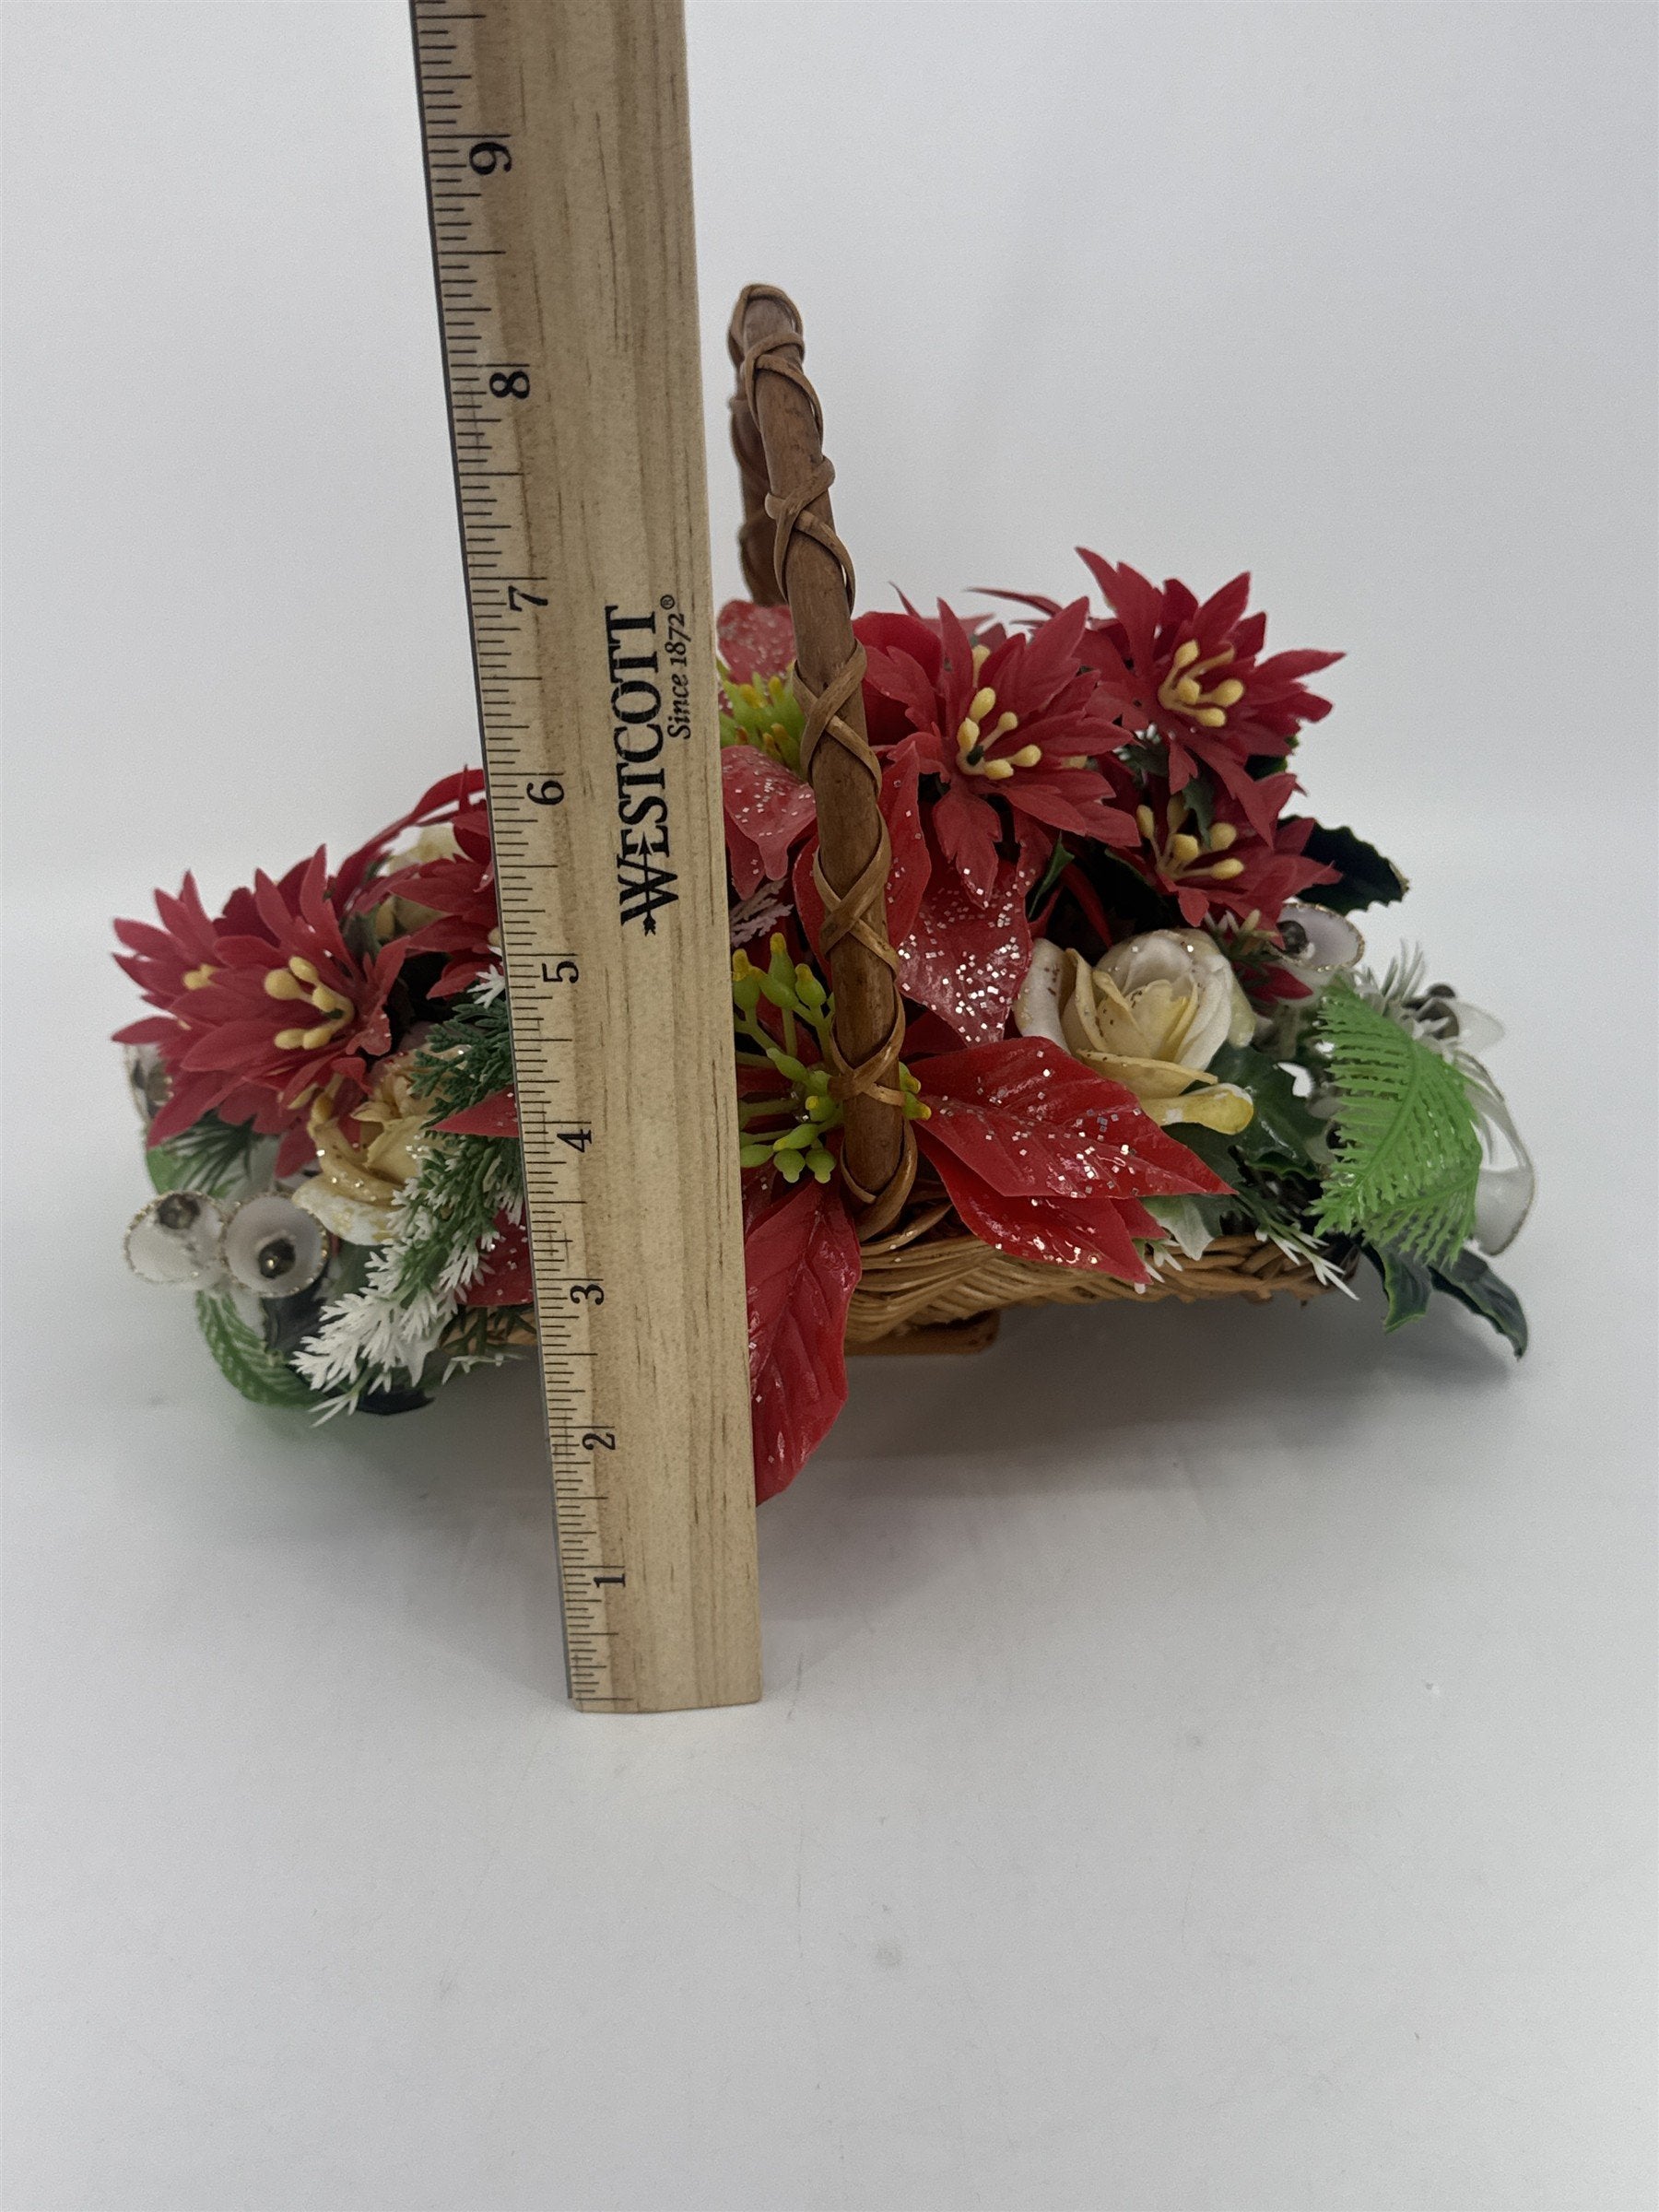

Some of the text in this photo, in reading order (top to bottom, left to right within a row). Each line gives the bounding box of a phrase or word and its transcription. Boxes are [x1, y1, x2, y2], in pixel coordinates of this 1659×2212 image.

[468, 140, 513, 176] 9
[488, 371, 532, 400] 8
[508, 585, 548, 612] 7
[664, 612, 692, 740] Since 1872
[605, 605, 679, 929] WESTCOTT
[526, 780, 565, 806] 6
[542, 960, 580, 984] 5
[556, 1128, 593, 1153] 4
[570, 1284, 605, 1306] 3
[582, 1431, 617, 1452] 2
[594, 1572, 627, 1589] 1
